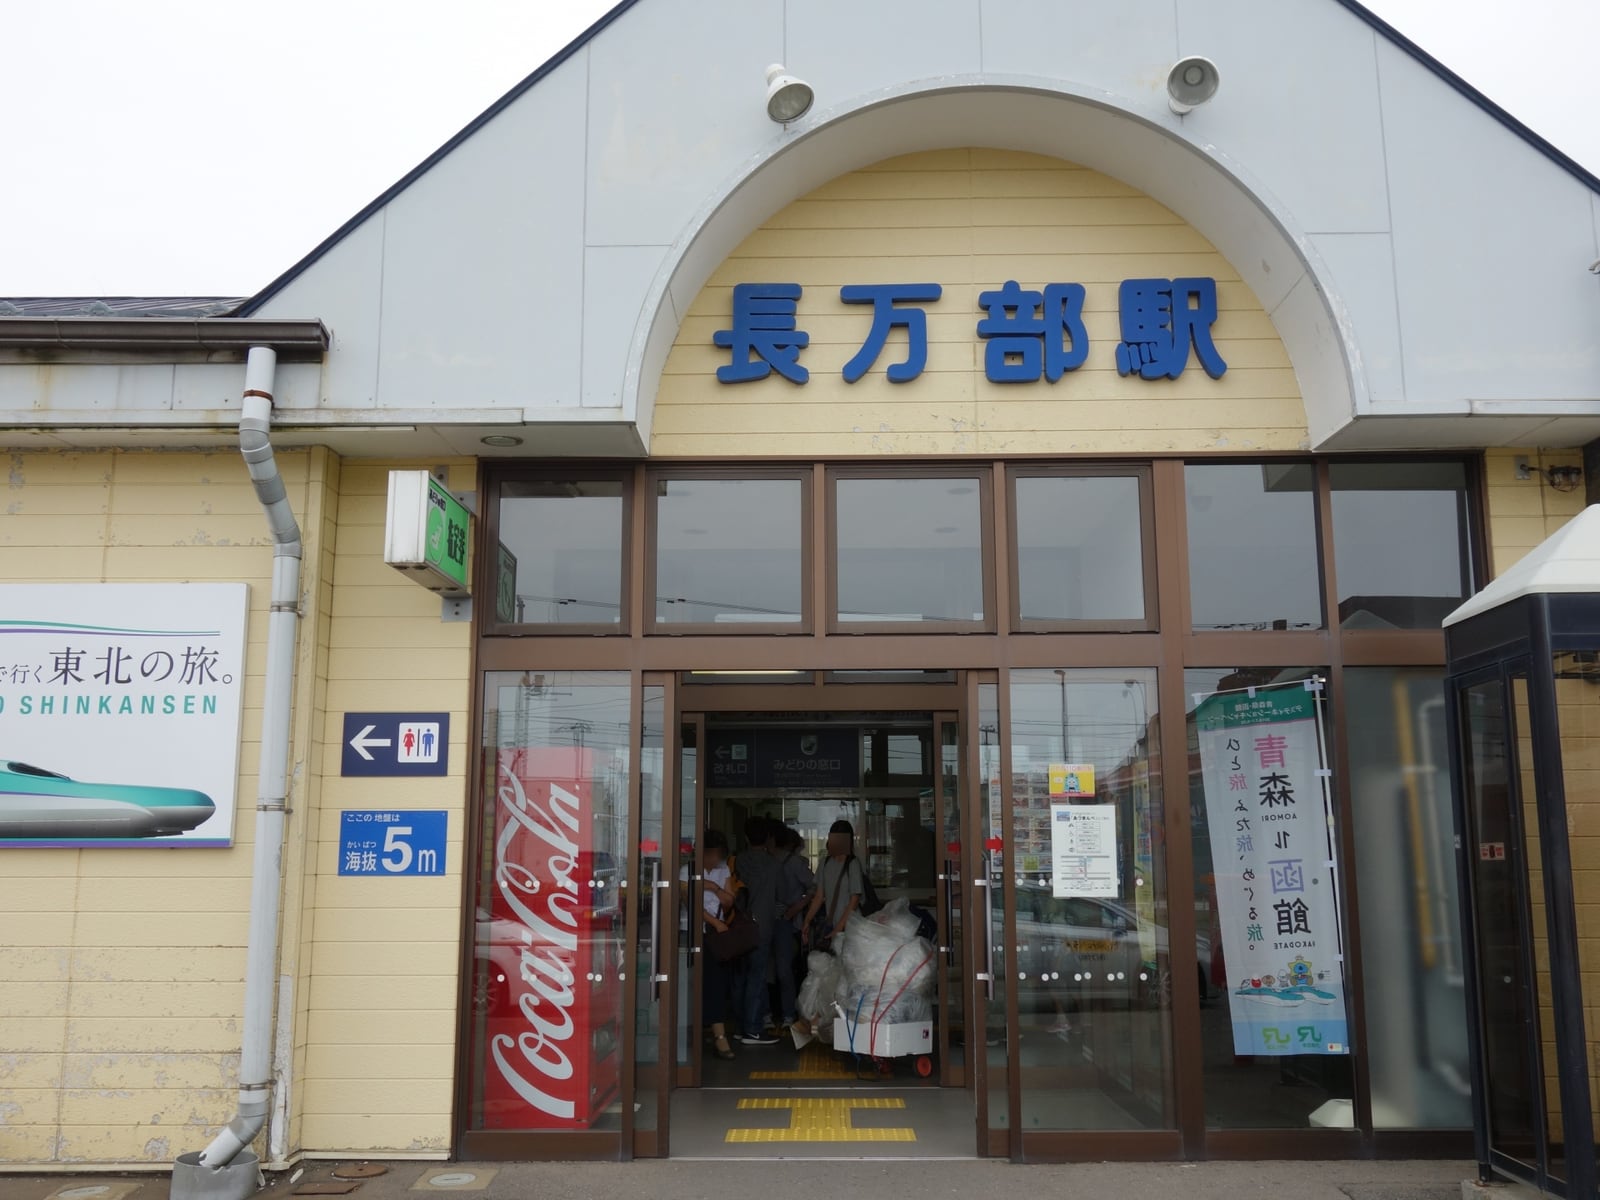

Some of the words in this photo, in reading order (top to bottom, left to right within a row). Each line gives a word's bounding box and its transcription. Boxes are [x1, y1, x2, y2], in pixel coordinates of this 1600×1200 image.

[713, 277, 1228, 384] 長万部駅
[19, 696, 218, 715] SHINKANSEN
[381, 826, 413, 873] 5
